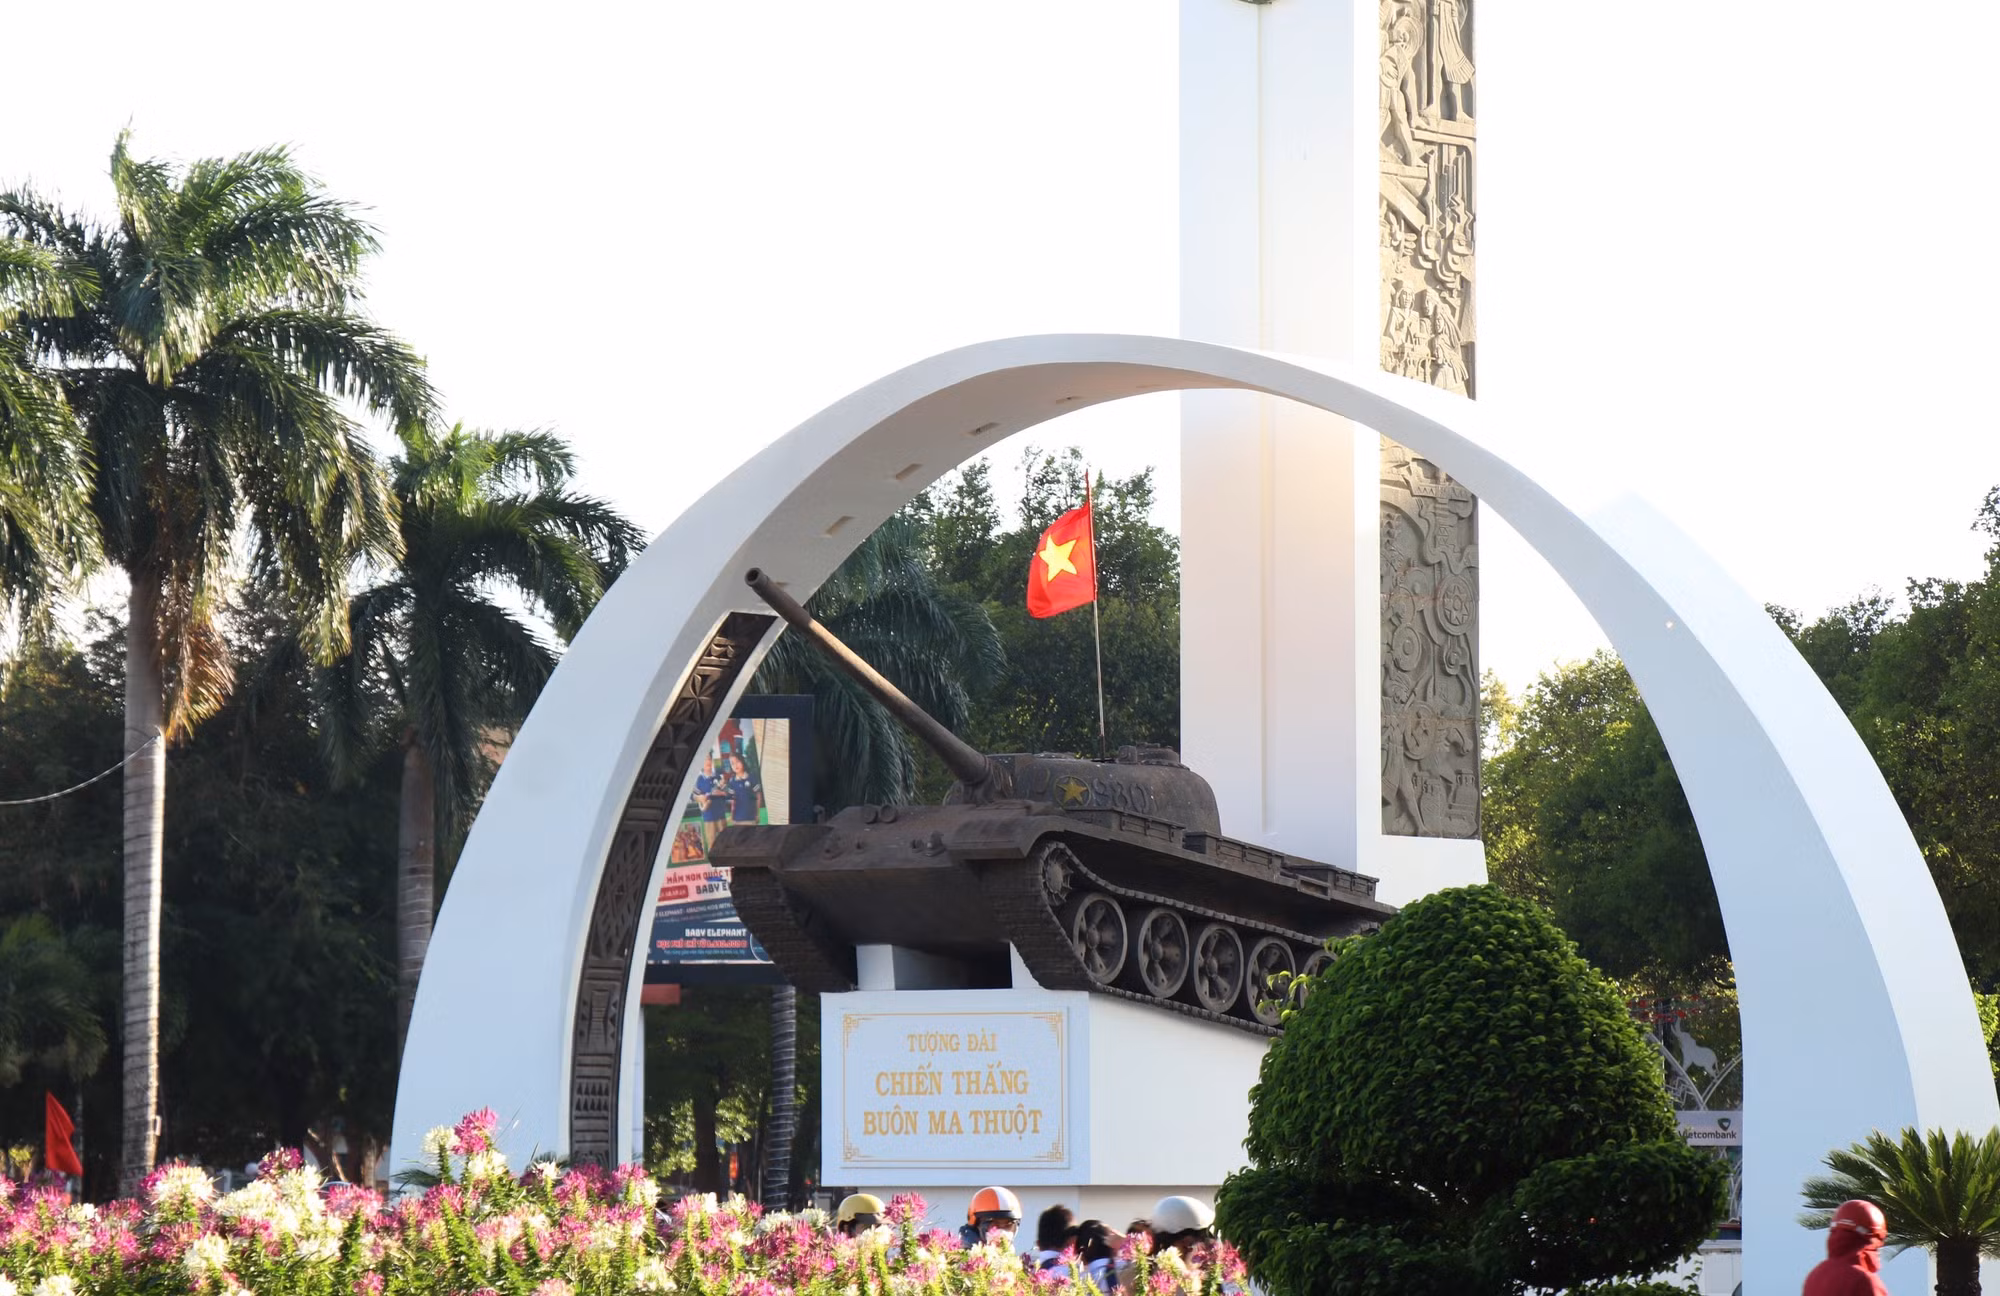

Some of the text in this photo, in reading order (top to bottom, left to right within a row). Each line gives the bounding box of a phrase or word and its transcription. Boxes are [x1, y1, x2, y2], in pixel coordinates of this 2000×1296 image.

[696, 882, 720, 895] BABY
[685, 928, 747, 937] BABY ELEPHANT
[907, 1027, 999, 1056] TƯỢNG ĐÀI
[875, 1060, 1030, 1096] CHIẾN THẮNG
[863, 1103, 1043, 1141] BUÔN MA THUỘT
[1678, 1130, 1737, 1139] Vietcombank
